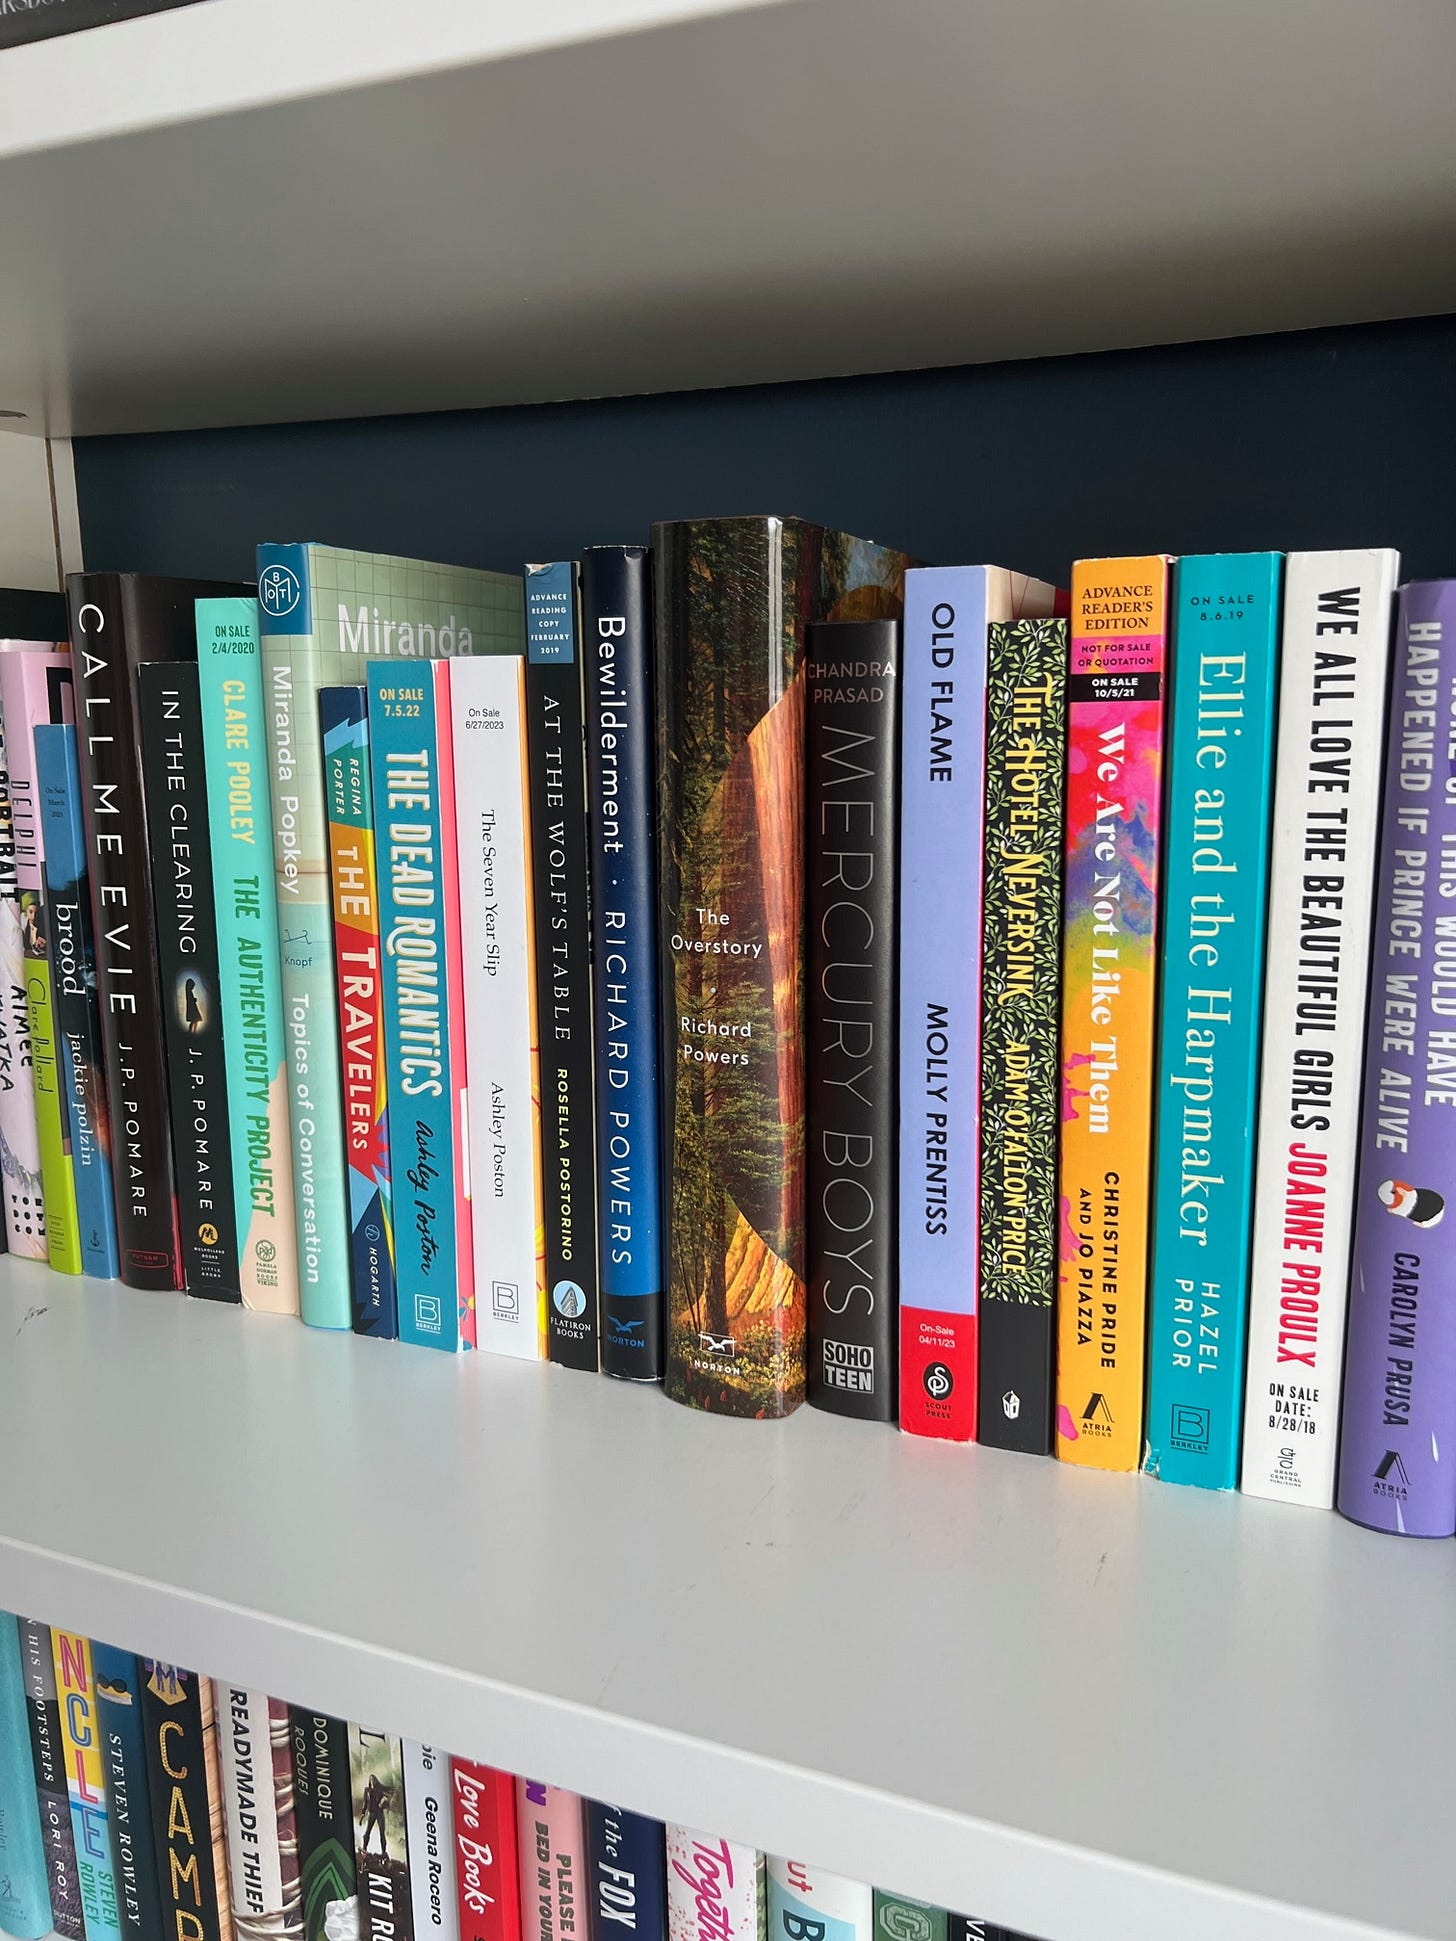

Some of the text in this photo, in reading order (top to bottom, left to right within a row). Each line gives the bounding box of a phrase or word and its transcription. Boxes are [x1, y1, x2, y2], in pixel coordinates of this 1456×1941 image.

[529, 593, 567, 602] ADVANCE
[531, 606, 567, 615] READING
[1081, 585, 1153, 600] ADVANCE
[1081, 600, 1154, 615] READER'S
[1190, 594, 1255, 606] ON SALE
[1199, 611, 1245, 622] 8.6.19
[211, 641, 255, 655] 2/4/2020
[214, 624, 251, 638] ON SALE
[337, 603, 474, 657] Miranda
[530, 633, 570, 642] FEBRUARY
[538, 619, 560, 629] COPY
[540, 646, 560, 655] 2019
[1081, 643, 1151, 653] NOT FOR SALE
[1085, 616, 1149, 630] EDITION
[379, 688, 424, 701] ON SALE
[807, 661, 897, 681] CHANDRA
[813, 687, 885, 705] PRASAD
[929, 602, 956, 783] OLD FLAME
[1094, 688, 1135, 698] 10/5/21
[384, 704, 420, 717] 7.5.22
[465, 720, 505, 731] 6/27/2023
[468, 708, 501, 719] On Sale
[222, 680, 256, 845] CLARE POOLEY
[272, 665, 300, 895] Miranda Popkey
[334, 758, 346, 815] PORTER
[350, 758, 362, 817] REGINA
[11, 780, 37, 867] DELPHI
[77, 603, 137, 1016] CALL ME EVIE
[160, 691, 197, 954] IN THE CLEARING
[543, 695, 571, 1041] AT THE WOLF'S TABLE
[997, 672, 1054, 1006] THE HOTEL NEVERSINK
[1289, 586, 1361, 1133] WE ALL LOVE THE BEAUTIFUL GIRLS
[232, 875, 261, 920] THE
[481, 808, 501, 977] The Seven Year Slip
[695, 908, 731, 927] The
[1375, 621, 1442, 1156] HAPPENED IF PRINCE WERE ALIVE
[55, 902, 86, 997] brood
[384, 749, 443, 1098] THE DEAD ROMANTICS
[598, 615, 632, 1266] Bewilderment RICHARD POWERS
[670, 933, 763, 959] Overstory
[1088, 721, 1127, 1135] We Are Not Like Them
[1170, 651, 1247, 1247] Ellie and the Harpmaker
[284, 955, 313, 967] Knopf
[237, 938, 270, 1108] AUTHENTICITY
[337, 845, 377, 1151] THE TRAVELERS
[821, 725, 877, 1317] MERCURY BOYS
[680, 1017, 752, 1038] Richard
[683, 1045, 750, 1066] Powers
[67, 1031, 92, 1166] jackie polzin
[925, 1003, 949, 1236] MOLLY PRENTISS
[118, 1042, 147, 1218] J.P. POMARE
[290, 994, 321, 1284] Topics of Conversation
[490, 1082, 505, 1198] Ashley Poston
[1001, 1039, 1030, 1278] ADAM O'FALLON PRICE
[247, 1115, 275, 1217] PROJECT
[556, 1068, 573, 1263] ROSELLA POSTORINO
[414, 1200, 440, 1277] Poston
[1076, 1188, 1094, 1347] AND JO PIAZZA
[1275, 1142, 1329, 1369] JOANNE PROULX
[368, 1247, 381, 1308] HOGARTH
[1101, 1171, 1120, 1369] CHRISTINE PRIDE
[492, 1312, 520, 1322] BERKLEY
[550, 1316, 592, 1332] FLATIRON
[918, 1334, 956, 1350] 04/11/23
[919, 1323, 955, 1337] On-Sale
[1172, 1278, 1194, 1370] PRIOR
[1198, 1281, 1220, 1375] HAZEL
[1383, 1252, 1420, 1427] CAROLYN PRUSA
[693, 1358, 741, 1376] NORTON
[824, 1341, 873, 1367] SOHO
[826, 1366, 873, 1392] TEEN
[925, 1401, 952, 1411] SCOUT
[926, 1409, 952, 1420] PRESS
[1269, 1382, 1319, 1402] ON SALE
[1275, 1400, 1312, 1419] DATE:
[1082, 1422, 1112, 1432] ATRIA
[1170, 1439, 1209, 1453] BERKLEY
[1269, 1416, 1316, 1435] 8/28/18
[1374, 1481, 1409, 1496] ATRIA
[294, 1725, 309, 1796] ROQUES
[312, 1717, 333, 1820] DOMINIQUE
[109, 1733, 141, 1927] STEVEN ROWLEY
[230, 1688, 264, 1914] READYMADE THIEF
[424, 1796, 442, 1926] Geena Rocero
[454, 1768, 495, 1915] Love Books
[598, 1818, 637, 1930] the FOX
